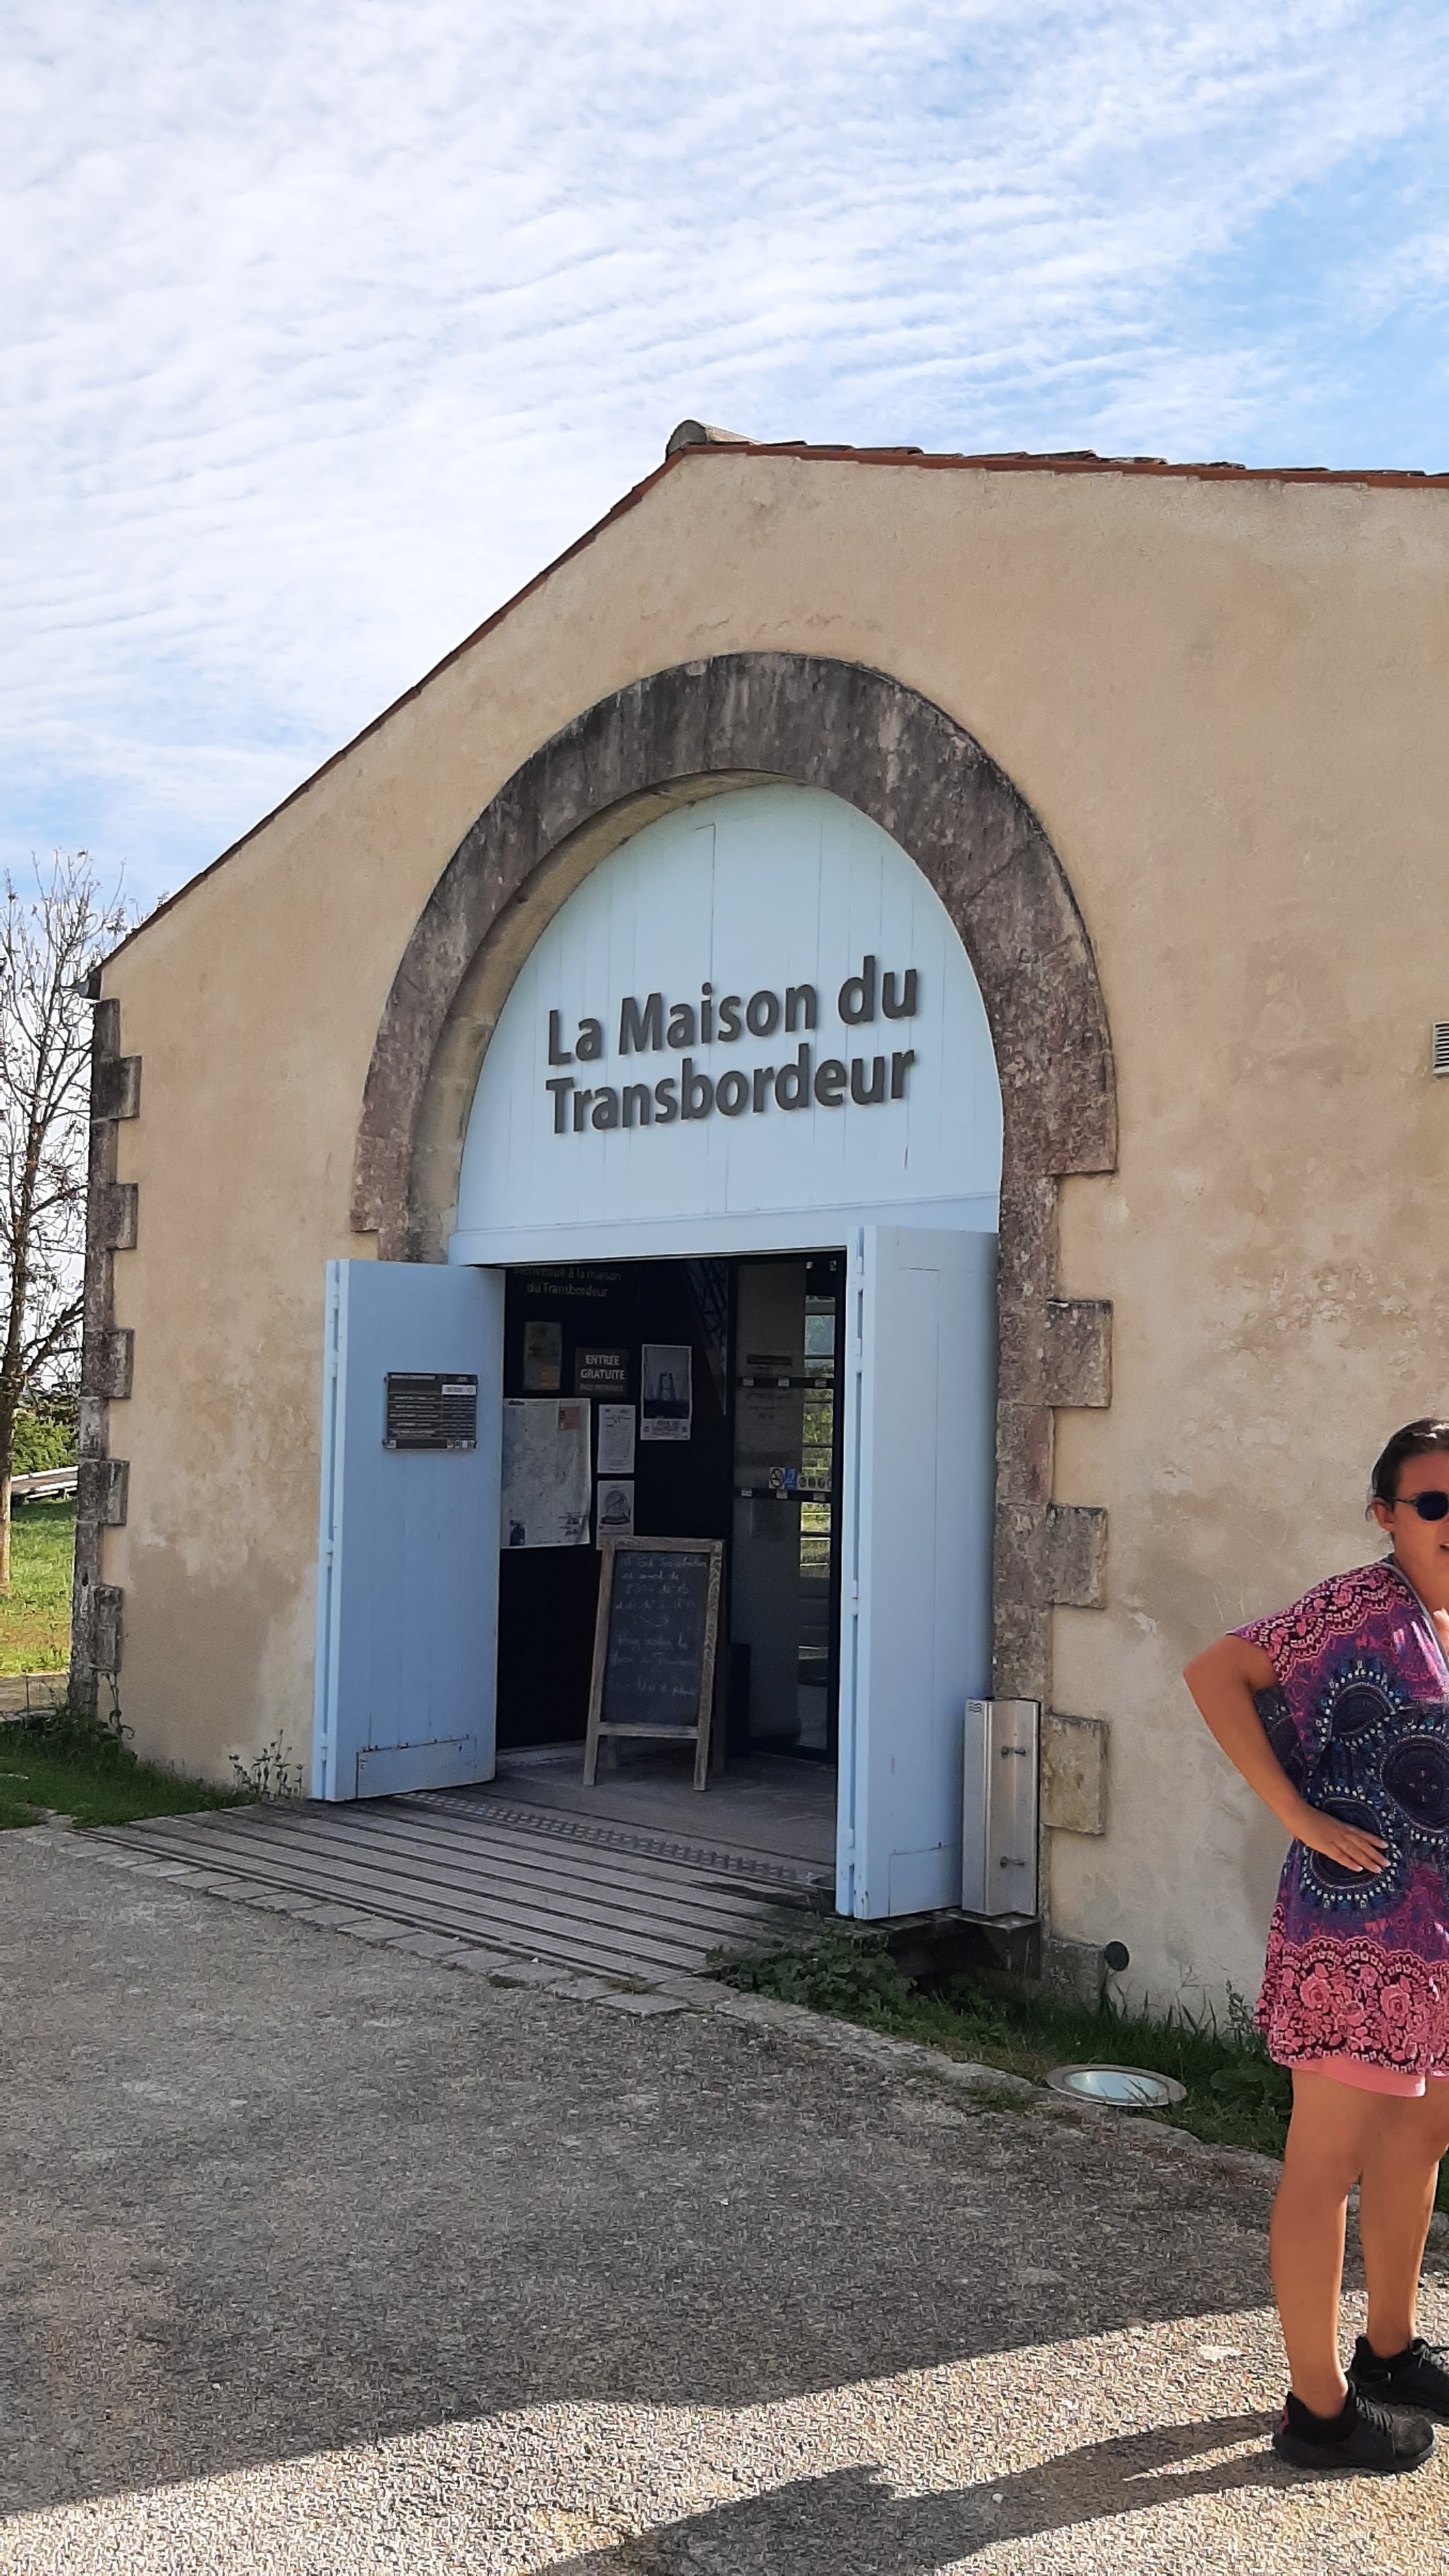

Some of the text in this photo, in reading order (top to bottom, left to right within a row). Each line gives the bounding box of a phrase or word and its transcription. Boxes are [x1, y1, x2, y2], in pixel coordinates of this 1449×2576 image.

[548, 954, 919, 1067] La Maison du
[545, 1043, 916, 1135] Transbordeur
[526, 1282, 608, 1297] du Transbordeur
[580, 1368, 625, 1380] GRATUITE
